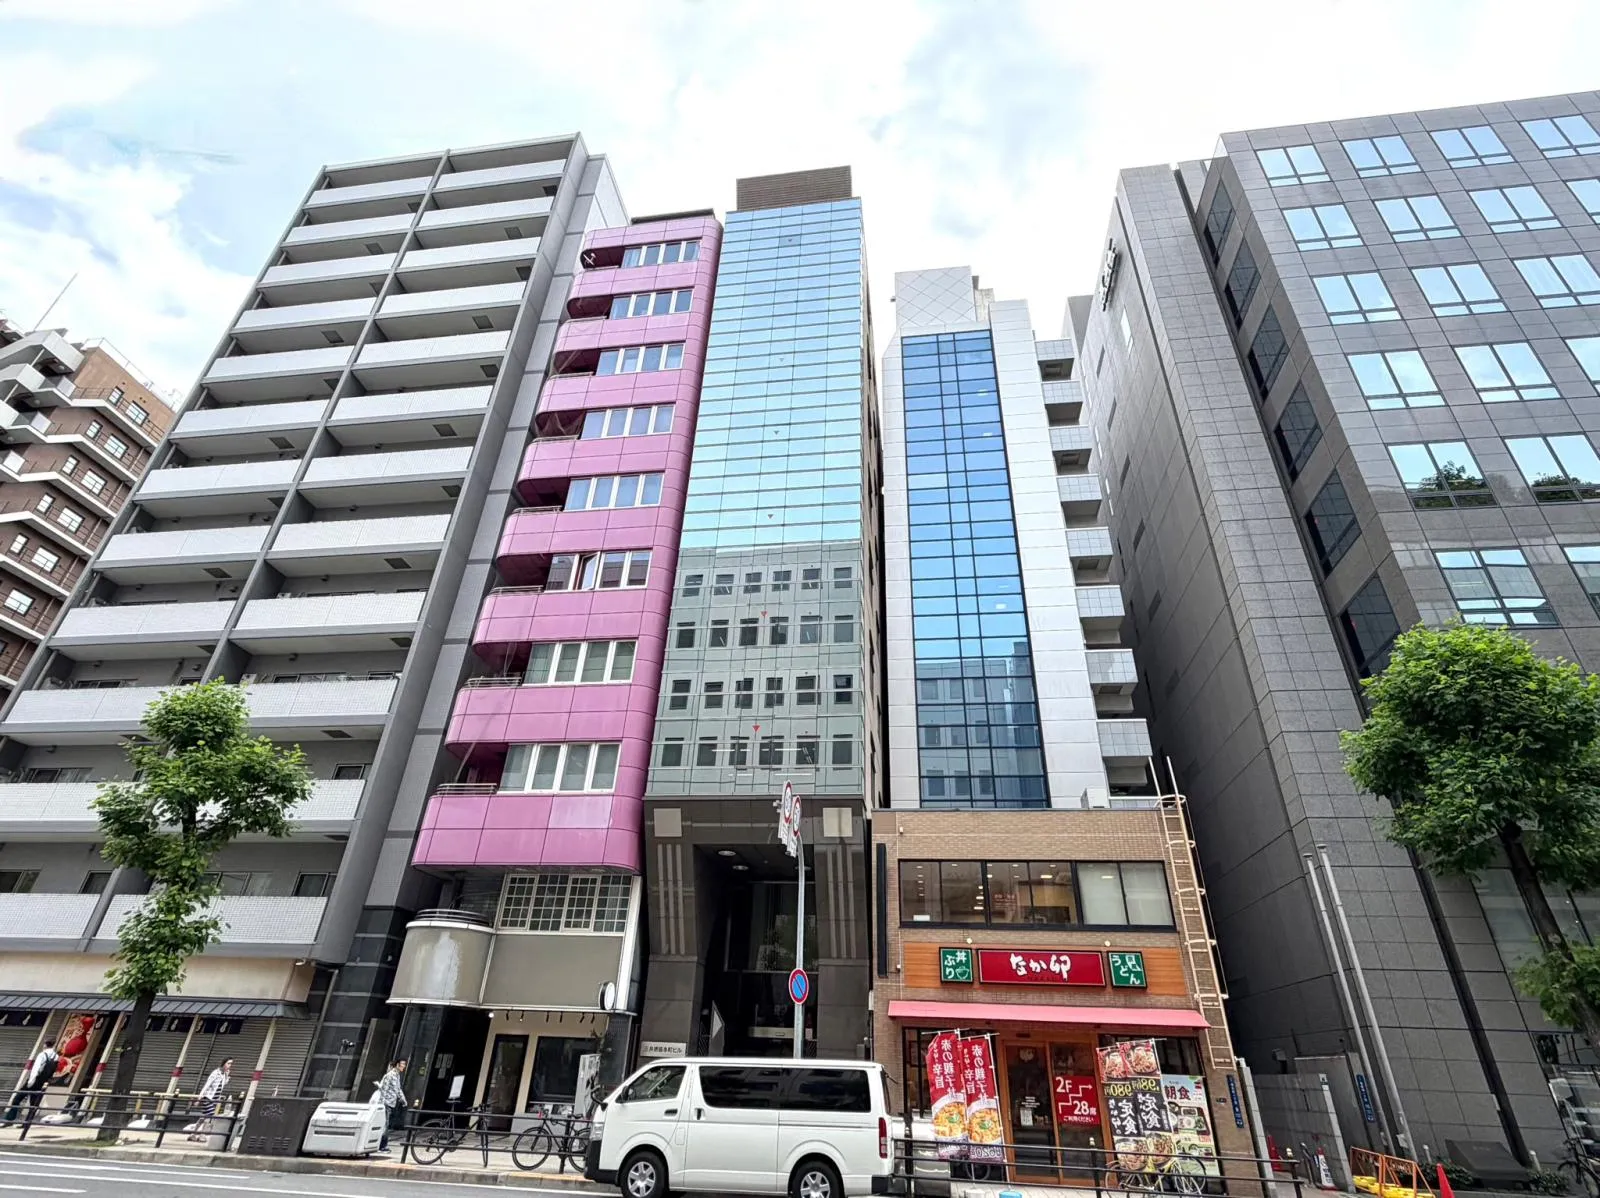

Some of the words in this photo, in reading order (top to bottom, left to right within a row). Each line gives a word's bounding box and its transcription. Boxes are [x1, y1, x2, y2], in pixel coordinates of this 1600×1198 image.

[1009, 953, 1071, 982] なか卯
[1111, 954, 1141, 985] うどん
[1055, 1076, 1073, 1093] 2F
